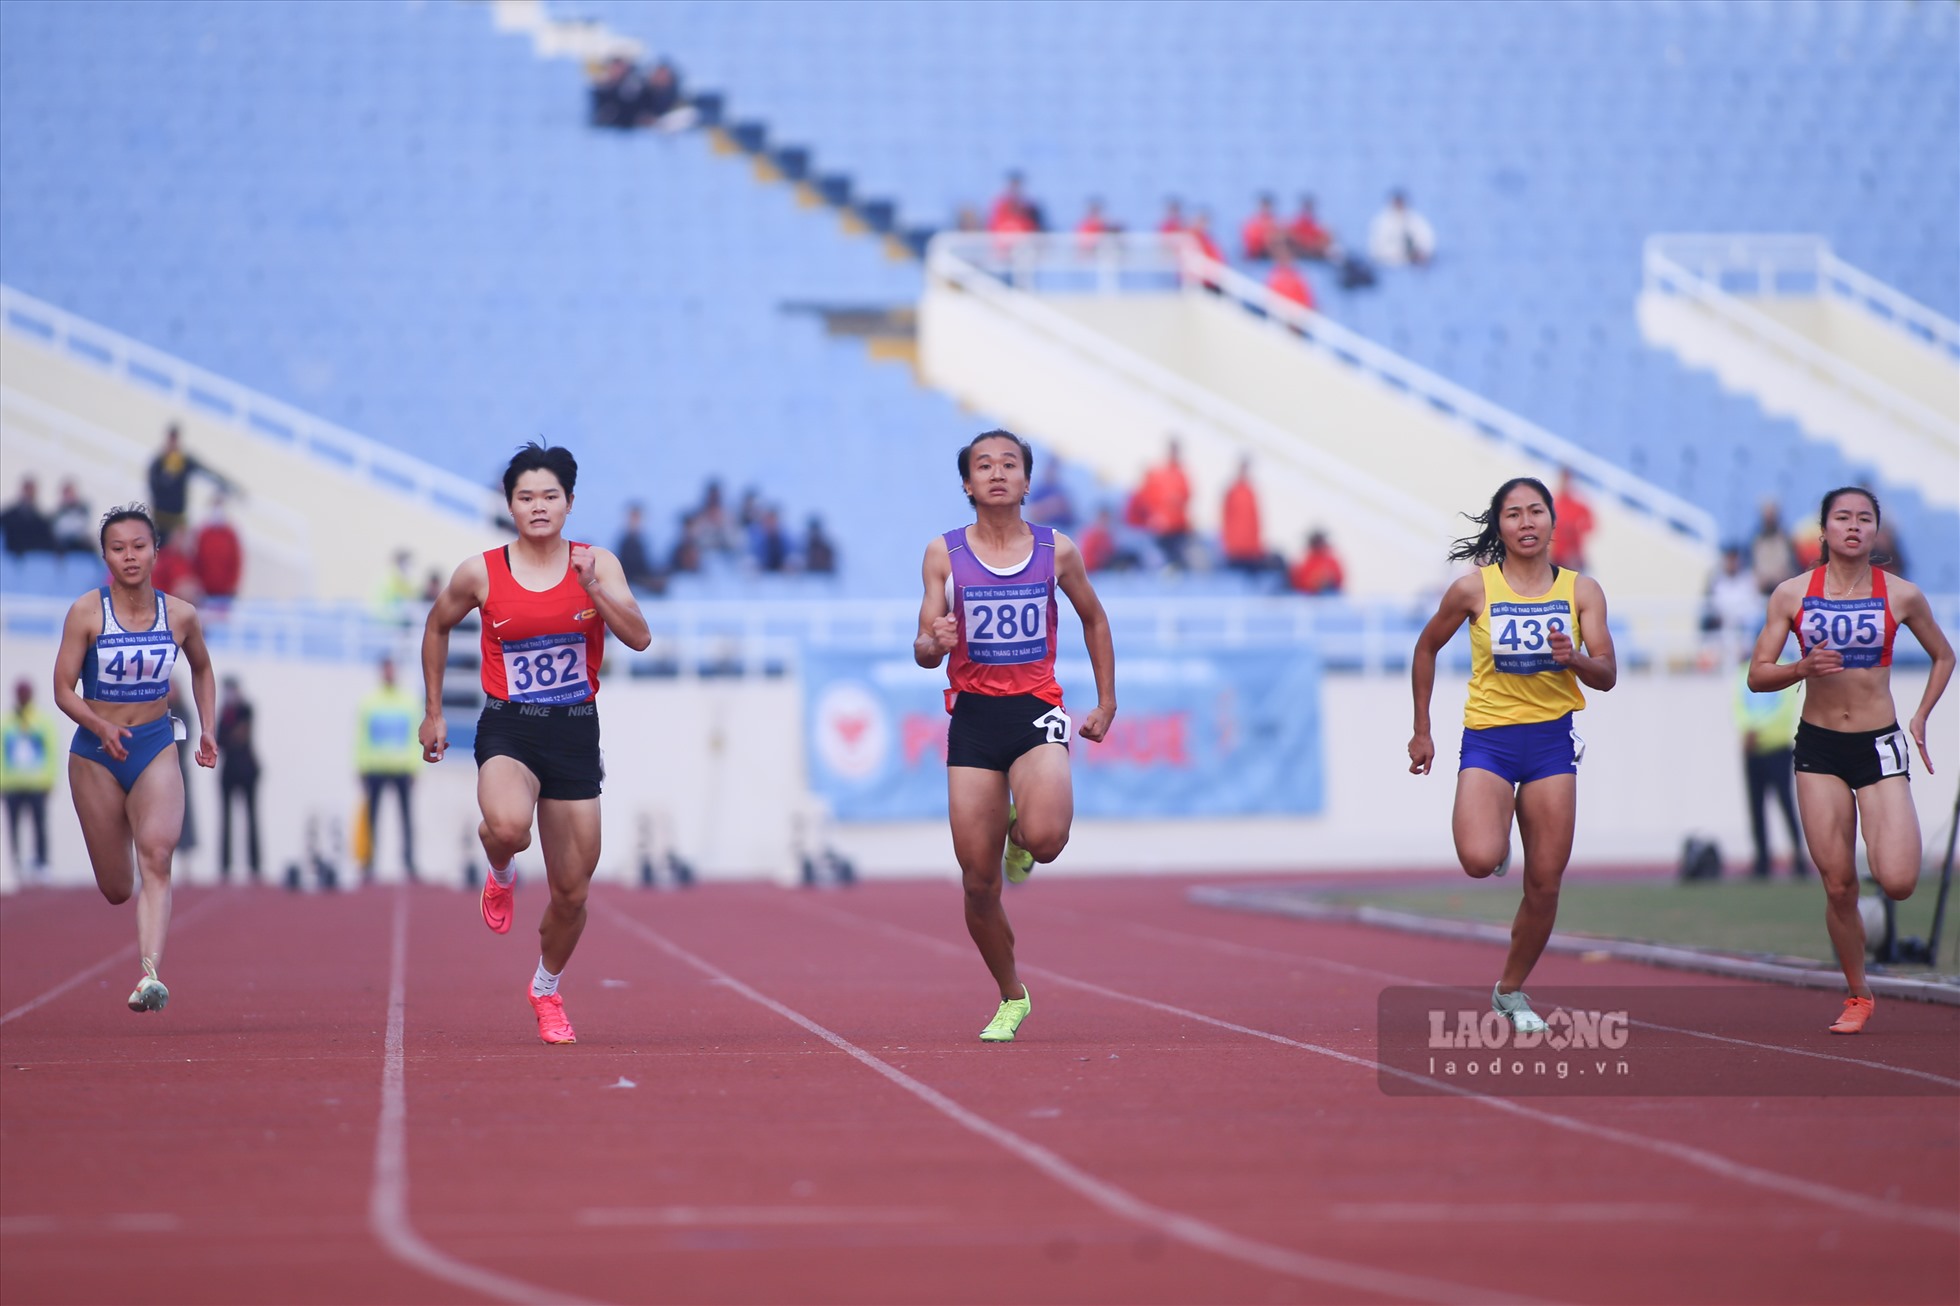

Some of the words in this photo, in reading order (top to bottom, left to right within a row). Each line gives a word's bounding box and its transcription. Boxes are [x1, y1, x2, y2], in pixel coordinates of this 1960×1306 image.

[972, 603, 1040, 639] 280
[1809, 612, 1878, 646] 305
[105, 649, 167, 681] 417
[513, 648, 579, 690] 382
[520, 705, 551, 717] NIKE
[568, 704, 594, 716] NIKE
[1884, 734, 1901, 770] 1
